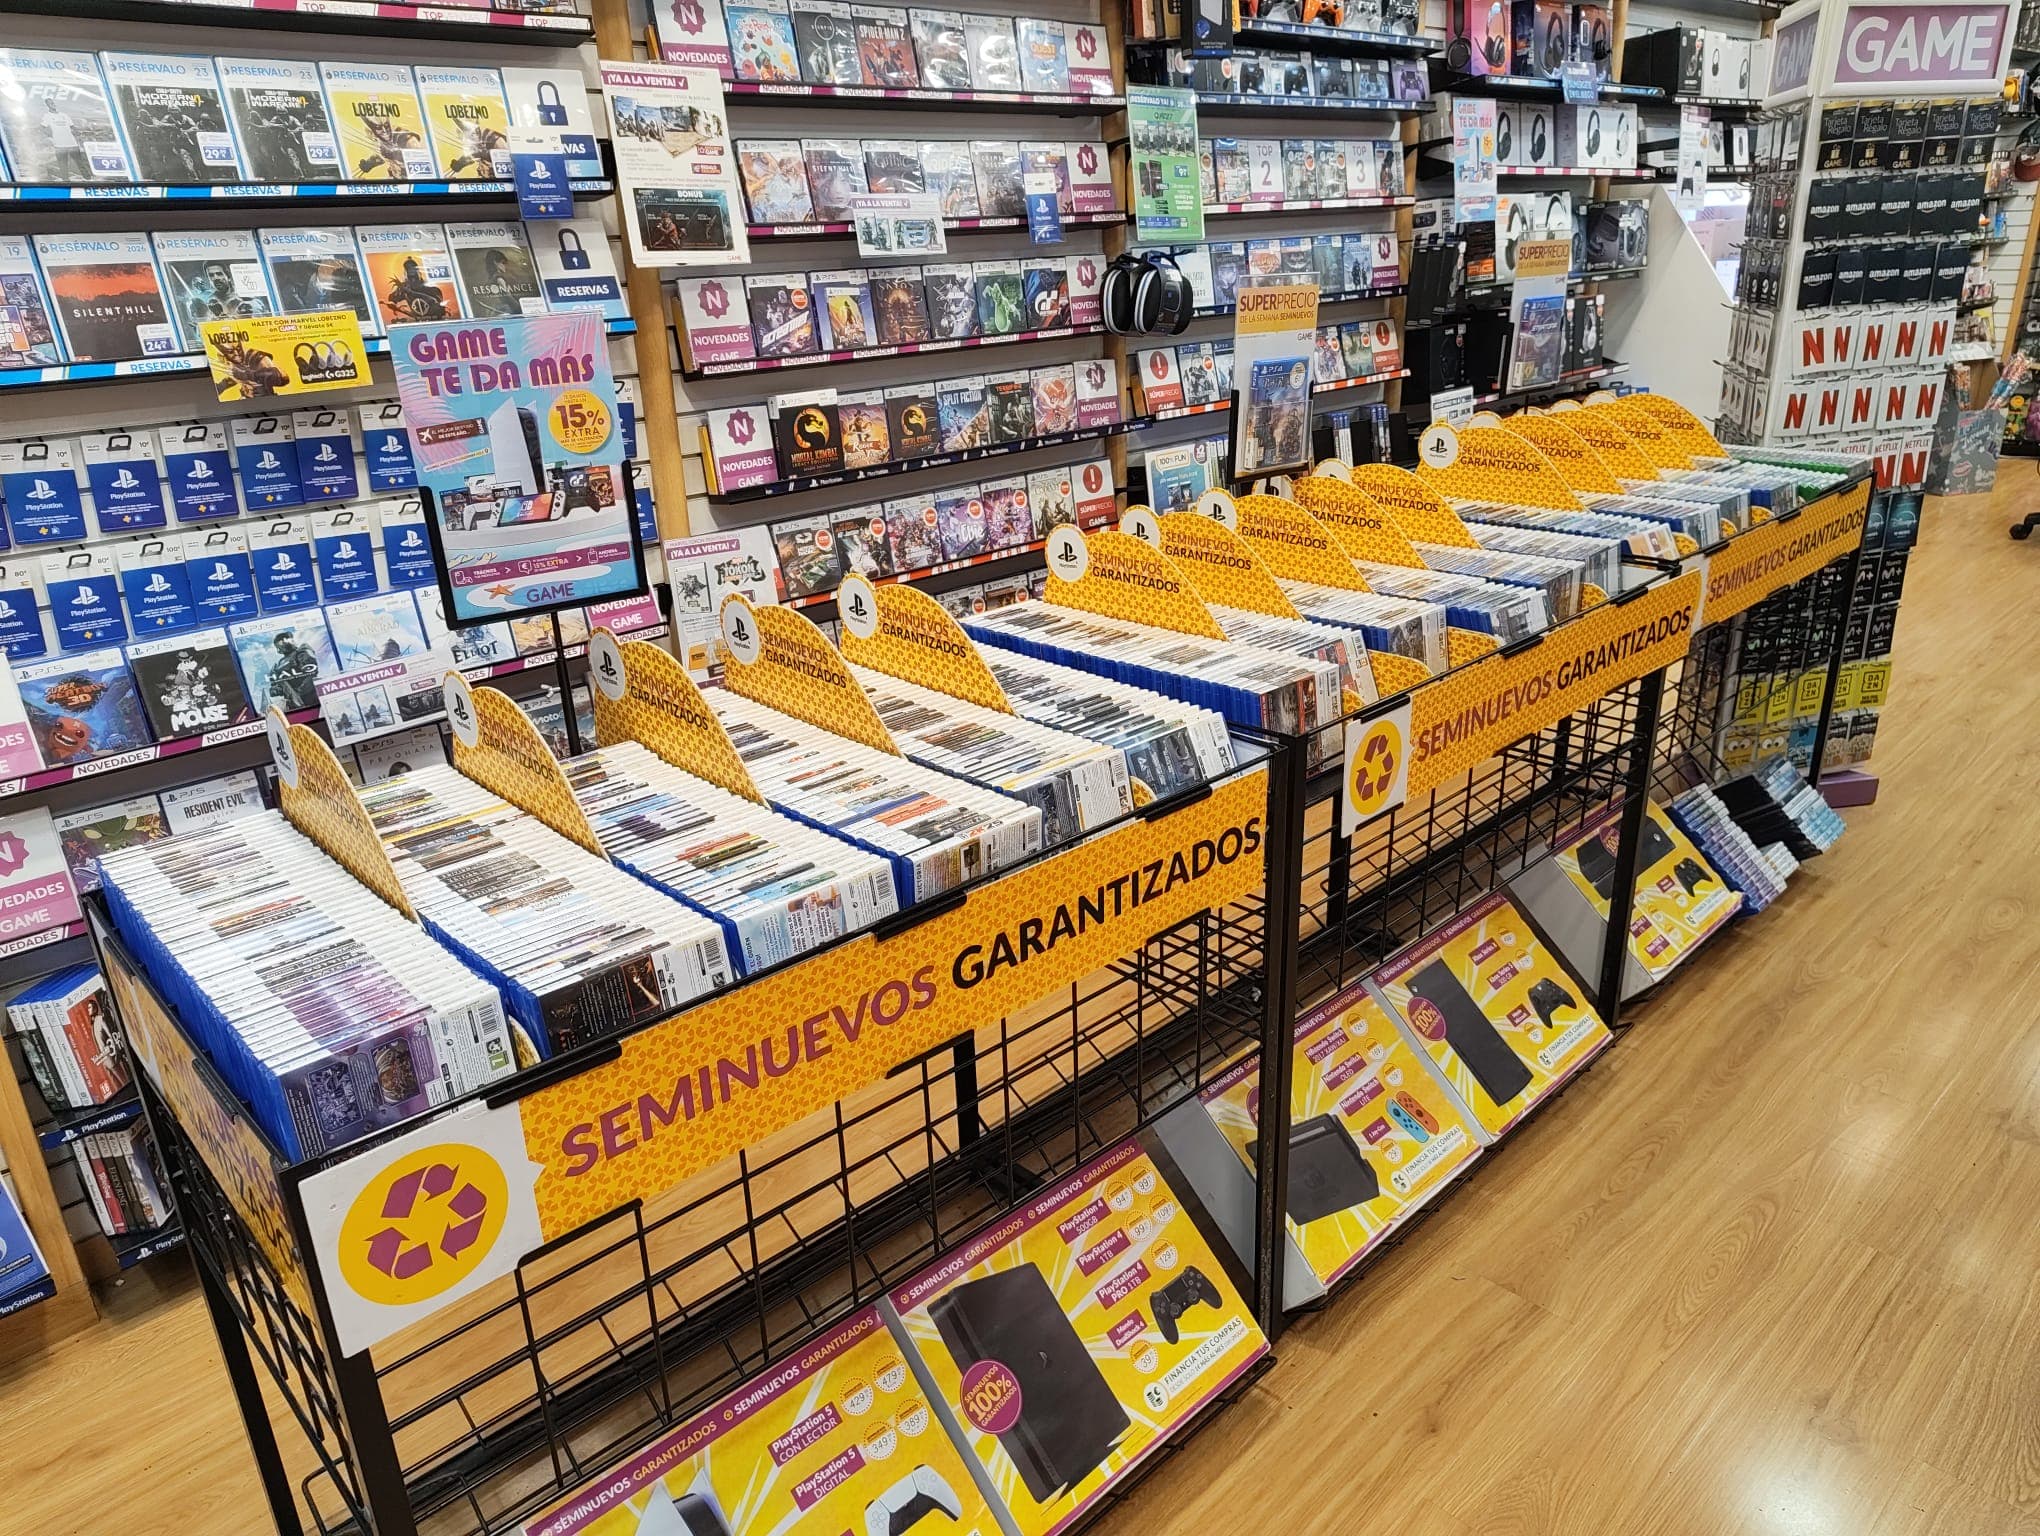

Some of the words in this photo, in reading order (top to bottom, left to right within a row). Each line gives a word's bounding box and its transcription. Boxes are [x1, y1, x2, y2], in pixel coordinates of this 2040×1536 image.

[530, 18, 548, 27] TOP
[1846, 15, 1998, 74] GAME
[668, 51, 728, 64] NOVEDADES
[352, 102, 400, 118] LOBEZNO
[445, 104, 488, 119] LOBEZNO
[1824, 117, 1848, 127] Tarjeta
[1256, 145, 1273, 156] TOP
[1261, 163, 1272, 185] 2
[85, 187, 150, 197] RESERVAS
[223, 186, 282, 196] RESERVAS
[347, 184, 400, 194] RESERVAS
[459, 183, 506, 193] RESERVAS
[677, 190, 704, 198] BONUS
[1073, 190, 1111, 199] NOVEDADES
[1810, 204, 1840, 215] amazon
[1845, 203, 1876, 213] amazon
[1881, 200, 1910, 211] amazon
[1917, 199, 1947, 211] amazon
[1950, 198, 1980, 210] amazon
[456, 227, 507, 238] RESÉRVALO
[50, 240, 120, 252] RESÉRVALO
[166, 237, 229, 248] RESÉRVALO
[1803, 272, 1833, 284] amazon
[1838, 270, 1863, 280] amazon
[1869, 268, 1899, 279] amazon
[1903, 267, 1932, 279] amazon
[1938, 267, 1964, 278] amazon
[557, 284, 609, 297] RESERVAS
[1240, 292, 1316, 312] SUPERPRECIO
[73, 306, 121, 318] SILENT
[125, 305, 154, 315] HILL
[208, 330, 250, 345] LOBEZNO
[694, 332, 749, 346] NOVEDADES
[1297, 332, 1313, 340] GAME
[409, 327, 508, 363] GAME
[130, 359, 192, 374] RESERVAS
[420, 365, 463, 397] TE
[471, 364, 521, 393] DA
[529, 349, 595, 387] MÁS
[942, 393, 959, 404] SPLIT
[1080, 402, 1117, 412] NOVEDADES
[556, 403, 605, 429] 15%
[564, 427, 600, 439] EXTRA
[1841, 445, 1866, 454] NETFLIX
[1875, 442, 1899, 453] NETFLIX
[1904, 439, 1929, 449] NETFLIX
[379, 454, 408, 463] PlayStation
[1462, 447, 1526, 460] SEMINUEVOS
[313, 464, 343, 473] PlayStation
[723, 456, 773, 473] NOVEDADES
[1460, 455, 1540, 472] GARANTIZADOS
[255, 471, 286, 481] PlayStation
[737, 475, 764, 488] GAME
[186, 480, 220, 491] PlayStation
[1357, 481, 1423, 499] SEMINUEVOS
[110, 490, 146, 501] PlayStation
[25, 501, 64, 512] PlayStation
[1299, 497, 1367, 514] SEMINUEVOS
[1089, 516, 1107, 527] GAME
[1242, 513, 1312, 535] SEMINUEVOS
[1165, 531, 1235, 554] SEMINUEVOS
[1241, 525, 1328, 551] GARANTIZADOS
[399, 549, 428, 557] PlayStation
[702, 543, 730, 553] VENTA!
[1709, 542, 1787, 602] SEMINUEVOS
[1788, 506, 1865, 562] GARANTIZADOS
[332, 560, 362, 570] PlayStation
[1091, 552, 1163, 577] SEMINUEVOS
[1165, 545, 1251, 571] GARANTIZADOS
[270, 571, 301, 582] PlayStation
[1093, 567, 1180, 594] GARANTIZADOS
[207, 581, 240, 592] PlayStation
[527, 582, 575, 603] GAME
[143, 592, 178, 604] PlayStation
[591, 596, 650, 614] NOVEDADES
[70, 604, 107, 617] PlayStation
[611, 614, 643, 629] GAME
[881, 607, 949, 637] SEMINUEVOS
[764, 631, 828, 665] SEMINUEVOS
[882, 622, 967, 659] GARANTIZADOS
[264, 664, 317, 682] HALO
[360, 667, 394, 681] VENTA!
[766, 650, 846, 689] GARANTIZADOS
[630, 672, 690, 704] SEMINUEVOS
[1415, 675, 1553, 762] SEMINUEVOS
[1556, 605, 1692, 690] GARANTIZADOS
[67, 692, 92, 706] 3D
[171, 705, 228, 731] MOUSE
[630, 690, 708, 731] GARANTIZADOS
[206, 722, 266, 743] NOVEDADE
[479, 712, 536, 751] SEMINUEVOS
[77, 750, 150, 775] NOVEDADES
[483, 732, 555, 783] GARANTIZADOS
[184, 801, 223, 819] RESIDENT
[224, 796, 246, 811] EVIL
[0, 881, 65, 909] VEDADES
[0, 908, 51, 933] GAME
[563, 966, 937, 1178] SEMINUEVOS
[952, 817, 1262, 989] GARANTIZADOS
[1325, 988, 1362, 1015] GARANTIZADOS
[1208, 1065, 1244, 1097] SEMINUEVOS
[1340, 1068, 1355, 1081] OLED
[1359, 1095, 1371, 1106] LITE
[81, 1111, 127, 1133] PlayStation
[1406, 1153, 1429, 1174] FINANCIA
[1437, 1125, 1461, 1149] COMPRAS
[908, 1257, 965, 1301] SEMINUEVOS
[964, 1217, 1024, 1262] GARANTIZADOS
[1034, 1178, 1083, 1216] SEMINUEVOS
[1082, 1144, 1136, 1183] GARANTIZADOS
[1059, 1205, 1098, 1234] PlayStation
[1078, 1236, 1117, 1266] PlayStation
[1100, 1250, 1114, 1265] 1TB
[1098, 1269, 1136, 1299] PlayStation
[1110, 1284, 1129, 1303] PRO
[1164, 1355, 1197, 1385] FINANCIA
[1196, 1343, 1211, 1358] TUS
[1209, 1318, 1242, 1346] COMPRAS
[969, 1374, 1012, 1421] 100%
[554, 1478, 631, 1534] SEMINUEVOS
[632, 1420, 717, 1482] GARANTIZADOS
[733, 1365, 801, 1415] SEMINUEVOS
[800, 1315, 874, 1370] GARANTIZADOS
[772, 1410, 826, 1453] PlayStation
[824, 1404, 834, 1416] 5
[779, 1443, 802, 1463] CON
[800, 1417, 838, 1449] LECTOR
[795, 1456, 849, 1498] PlayStation
[813, 1468, 851, 1500] DIGITAL
